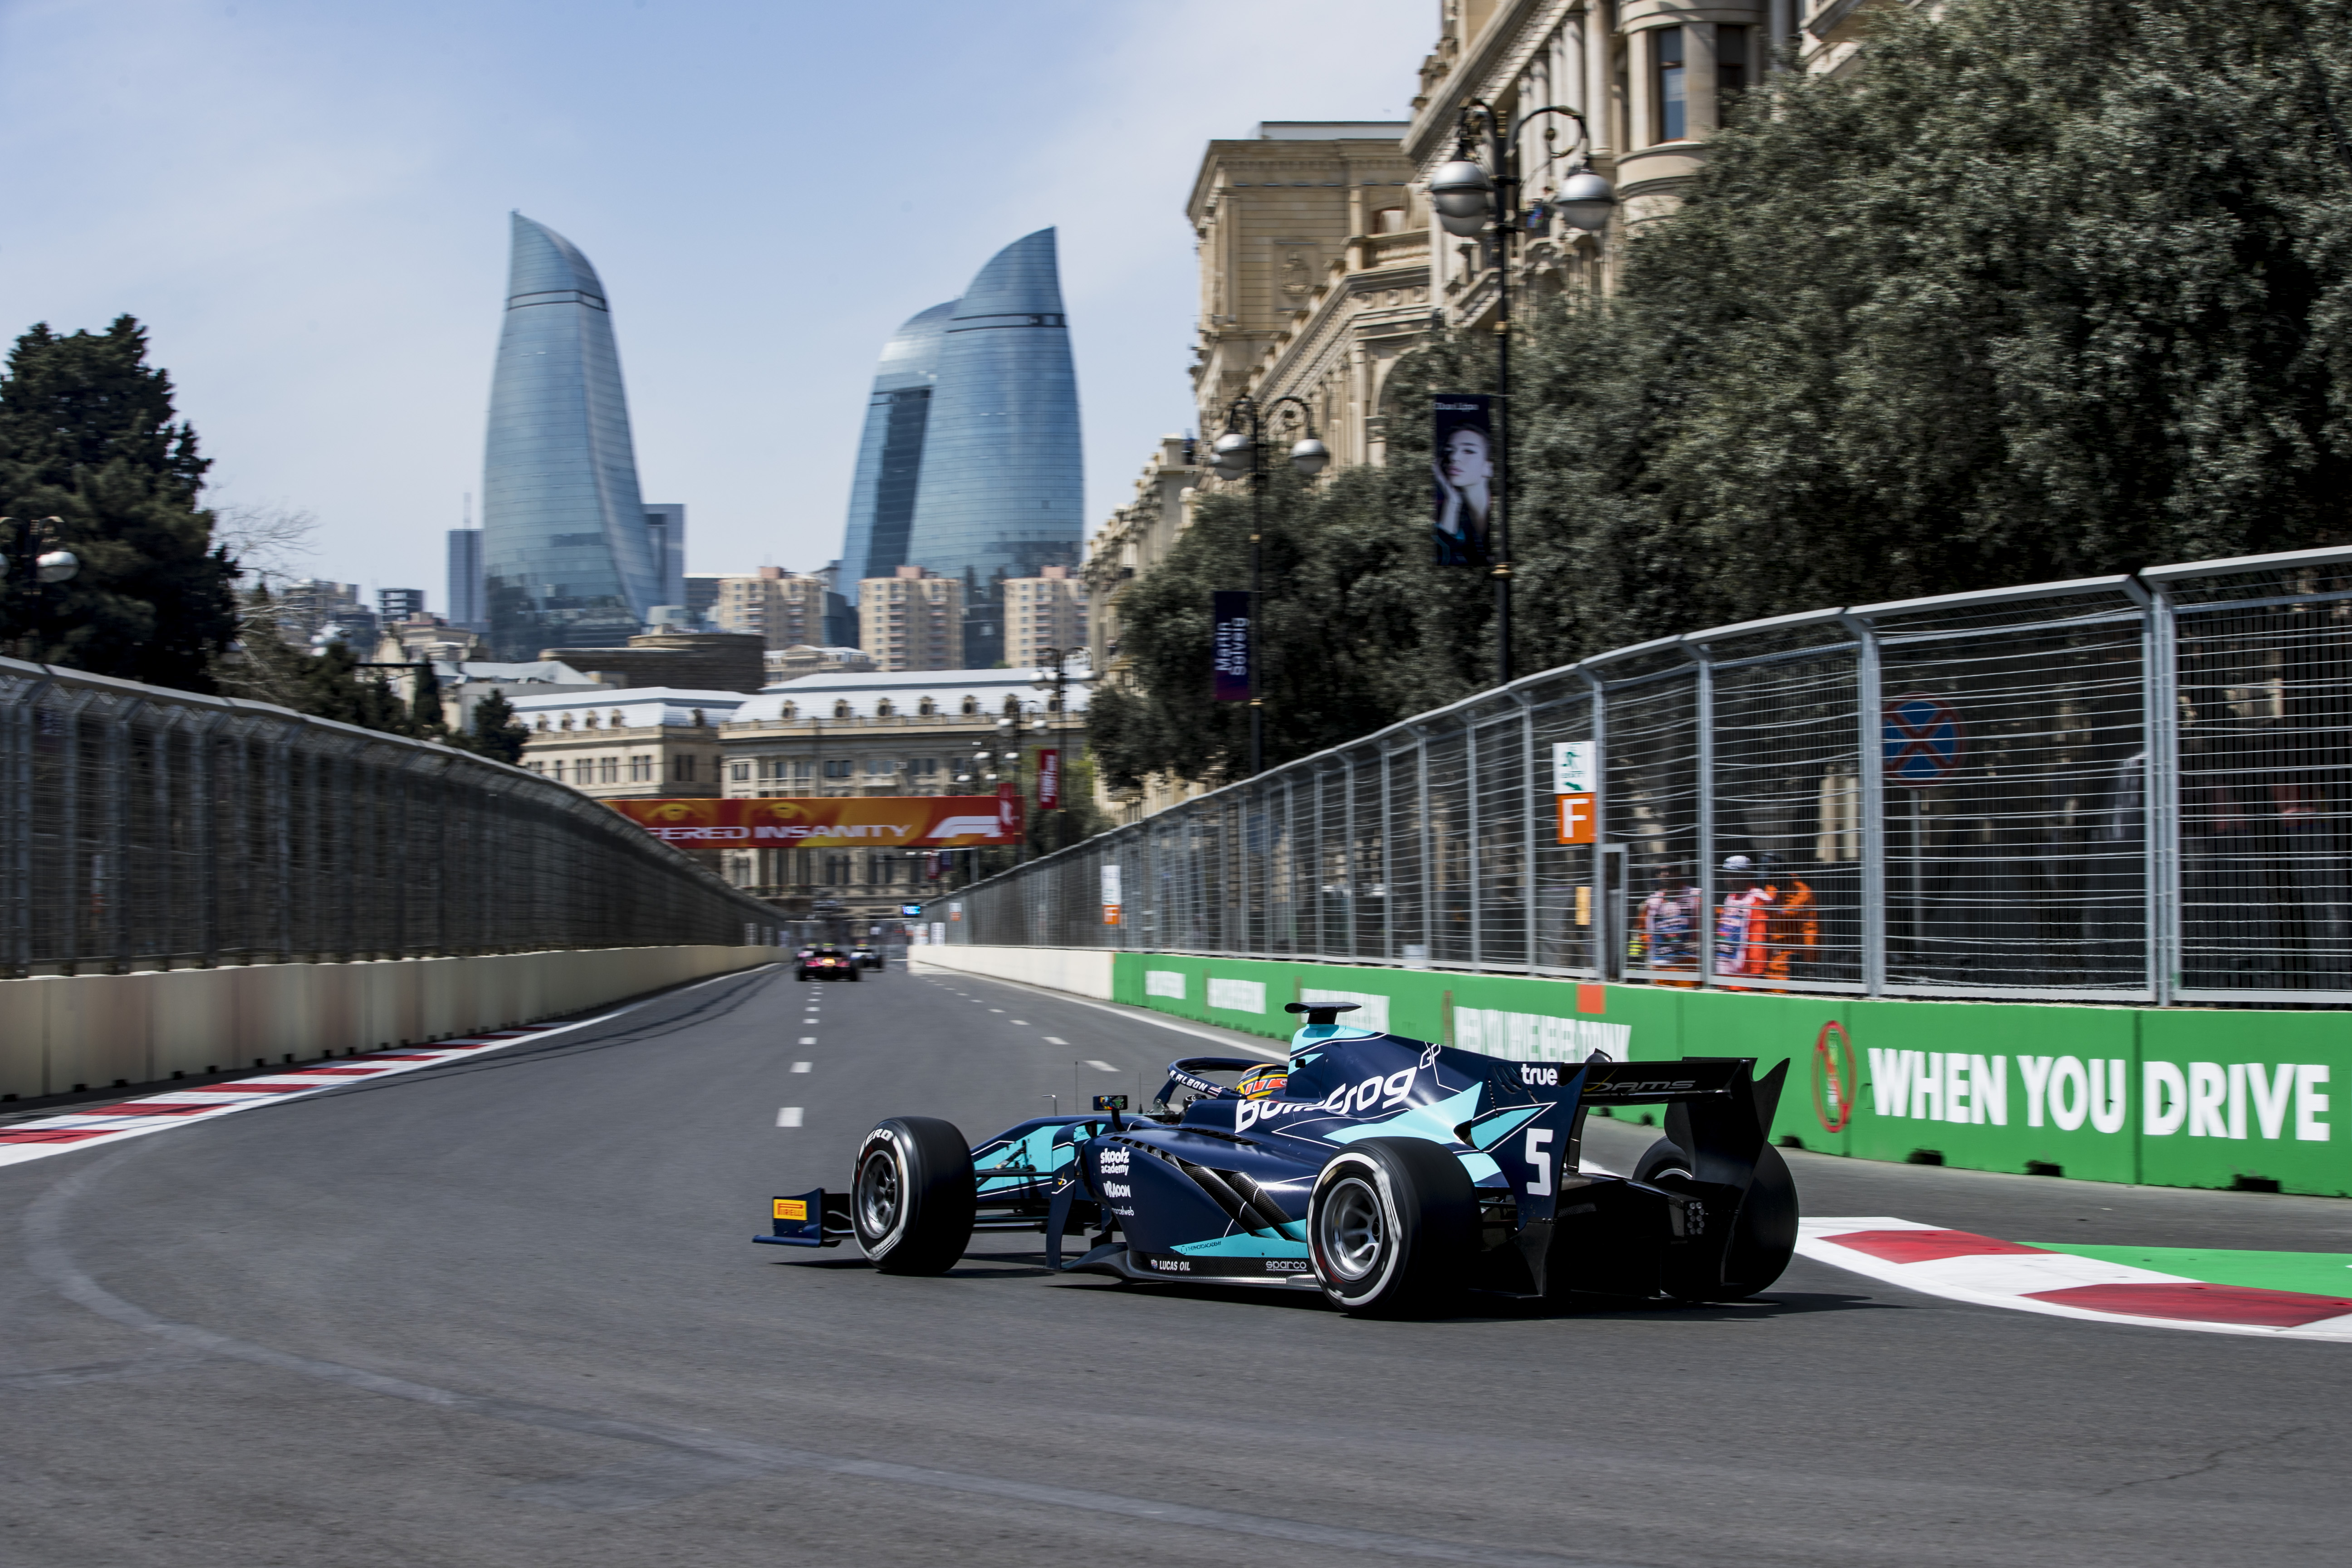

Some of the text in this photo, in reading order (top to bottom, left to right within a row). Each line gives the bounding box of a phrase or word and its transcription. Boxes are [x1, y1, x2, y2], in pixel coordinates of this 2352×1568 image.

[1214, 622, 1232, 670] Martin
[1229, 617, 1250, 676] Solveig
[1562, 799, 1590, 838] F
[754, 825, 912, 838] INSANITY
[1419, 1043, 1441, 1069] GP
[1521, 1063, 1558, 1086] true
[1585, 1080, 1696, 1092] DAMS
[1867, 1048, 2331, 1141] WHEN YOU DRIVE
[1100, 1147, 1130, 1164] skoolz
[1525, 1128, 1553, 1196] 5
[1101, 1162, 1129, 1176] academy
[778, 1203, 804, 1216] PIRELLI
[1159, 1260, 1178, 1270] LUCAS
[1180, 1261, 1191, 1271] OIL
[1266, 1261, 1307, 1271] sparco
